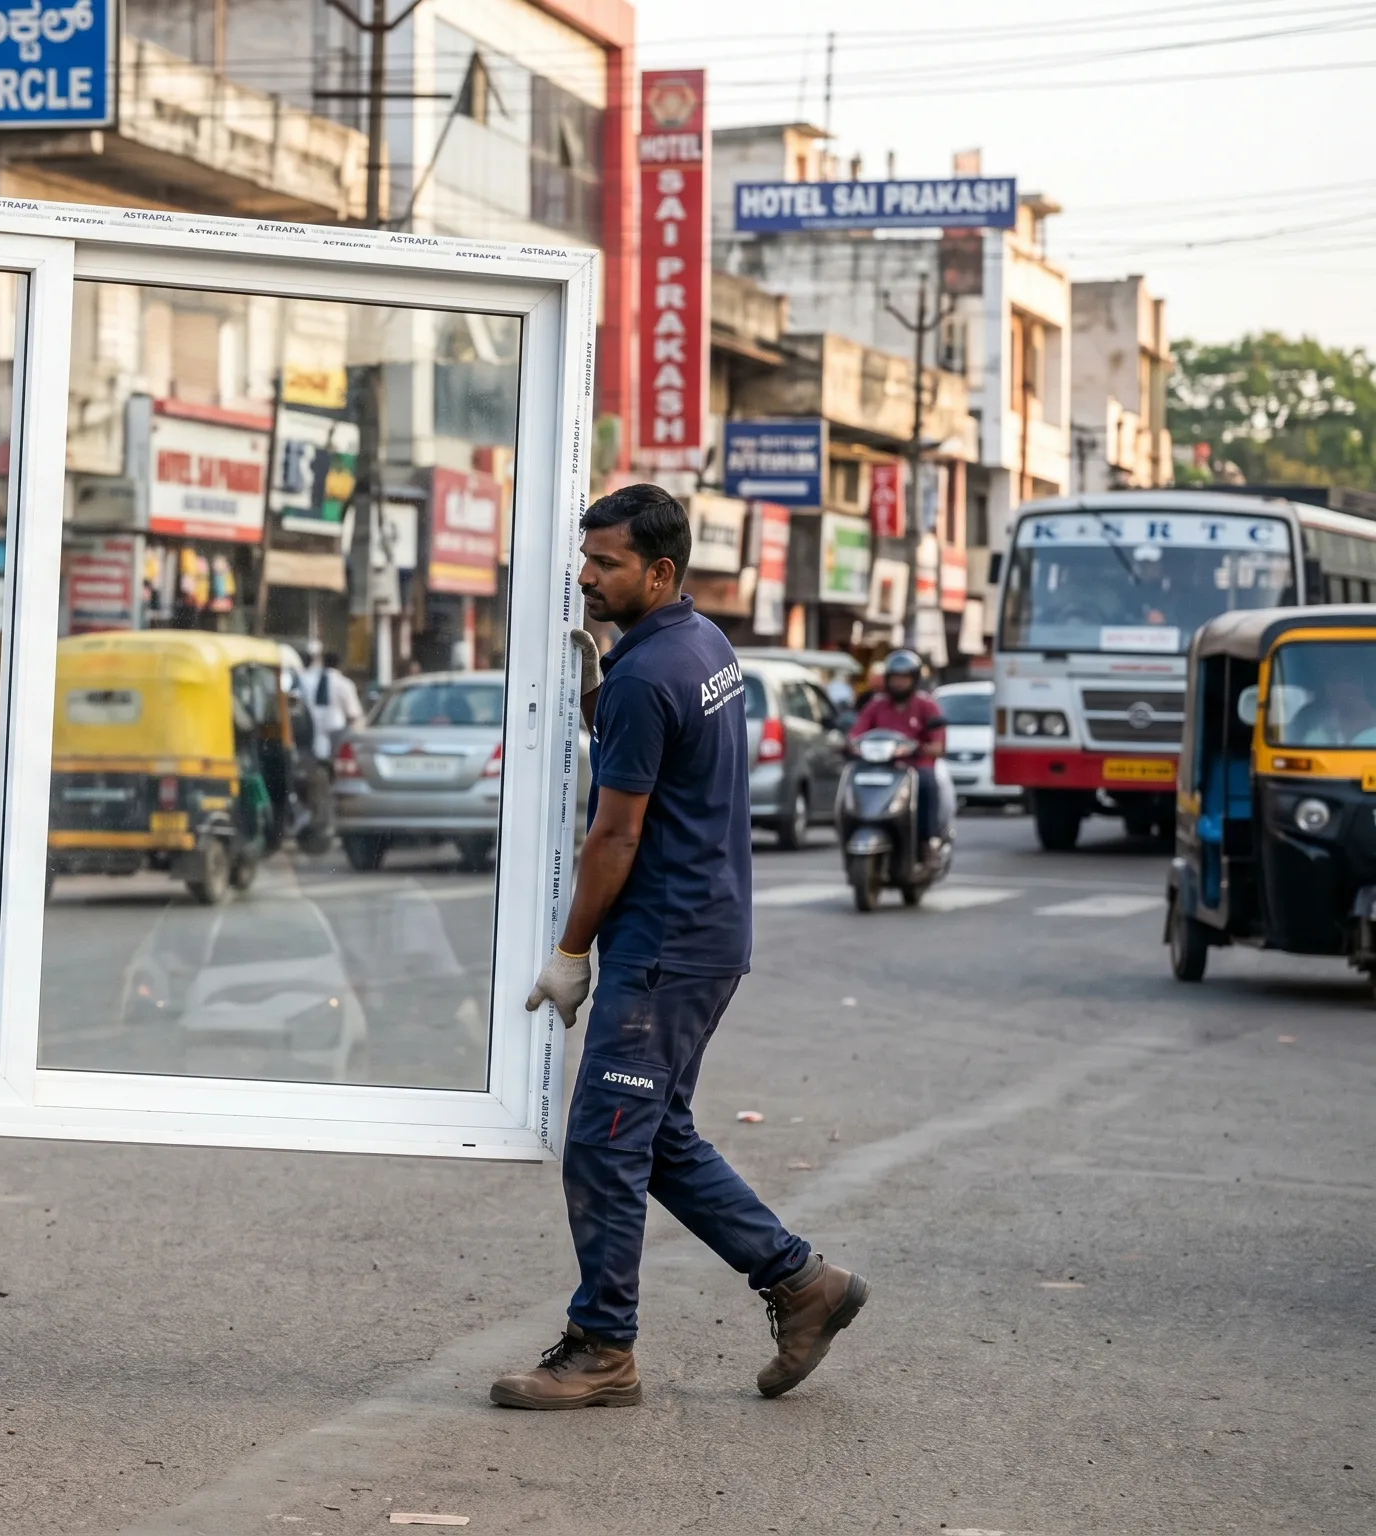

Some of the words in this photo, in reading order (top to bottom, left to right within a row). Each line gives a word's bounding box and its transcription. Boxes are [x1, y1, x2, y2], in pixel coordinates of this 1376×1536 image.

[740, 186, 828, 218] HOTEL
[833, 184, 877, 216] SAI
[883, 181, 1010, 214] PRAKASH
[602, 1071, 654, 1090] ASTRAPIA
